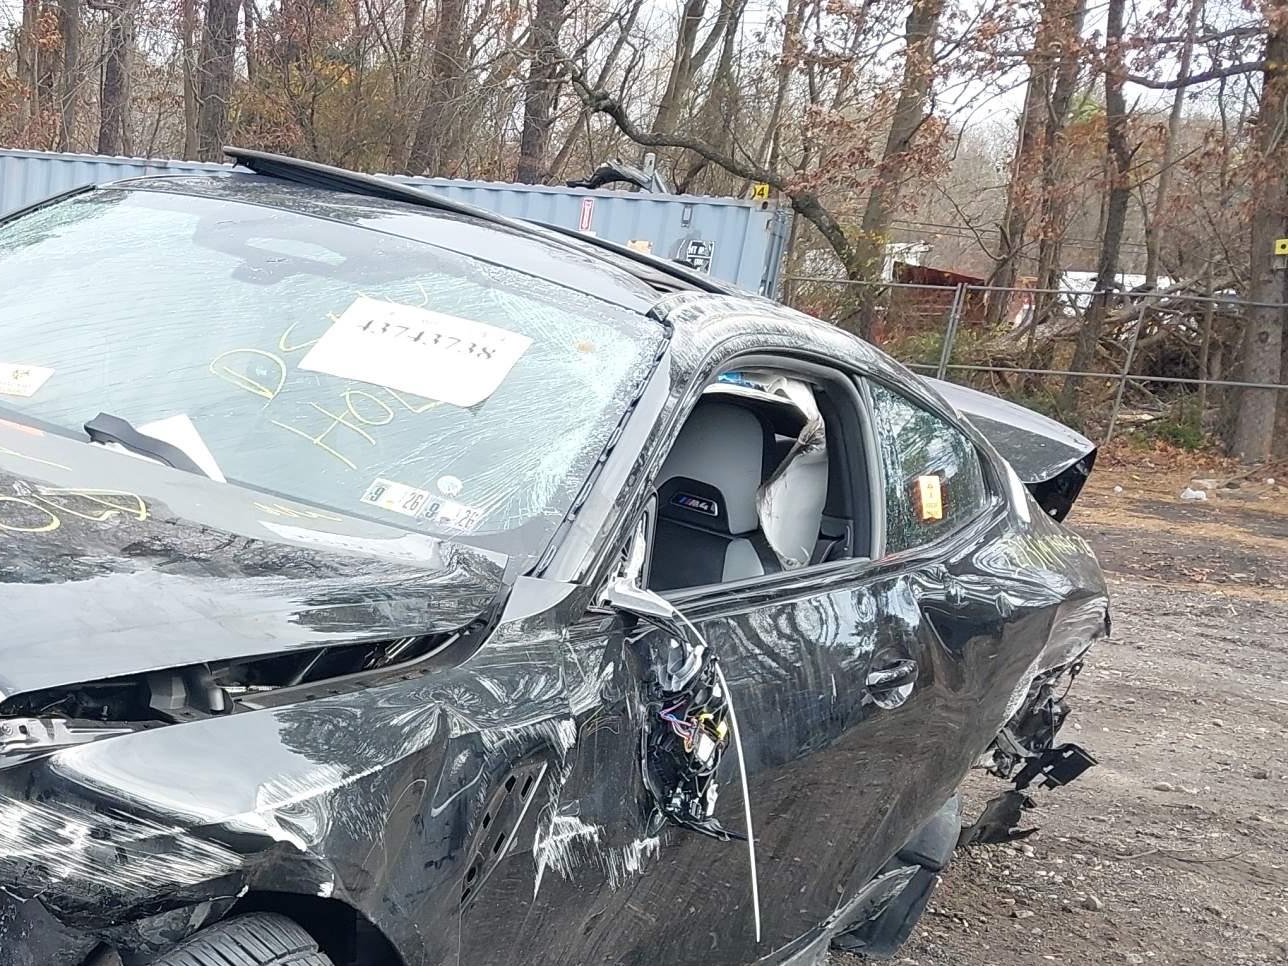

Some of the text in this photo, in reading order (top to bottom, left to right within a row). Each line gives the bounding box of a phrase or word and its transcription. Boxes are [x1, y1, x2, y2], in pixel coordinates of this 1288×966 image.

[356, 318, 497, 361] 43743738
[270, 386, 441, 470] HOL
[402, 492, 424, 511] 26
